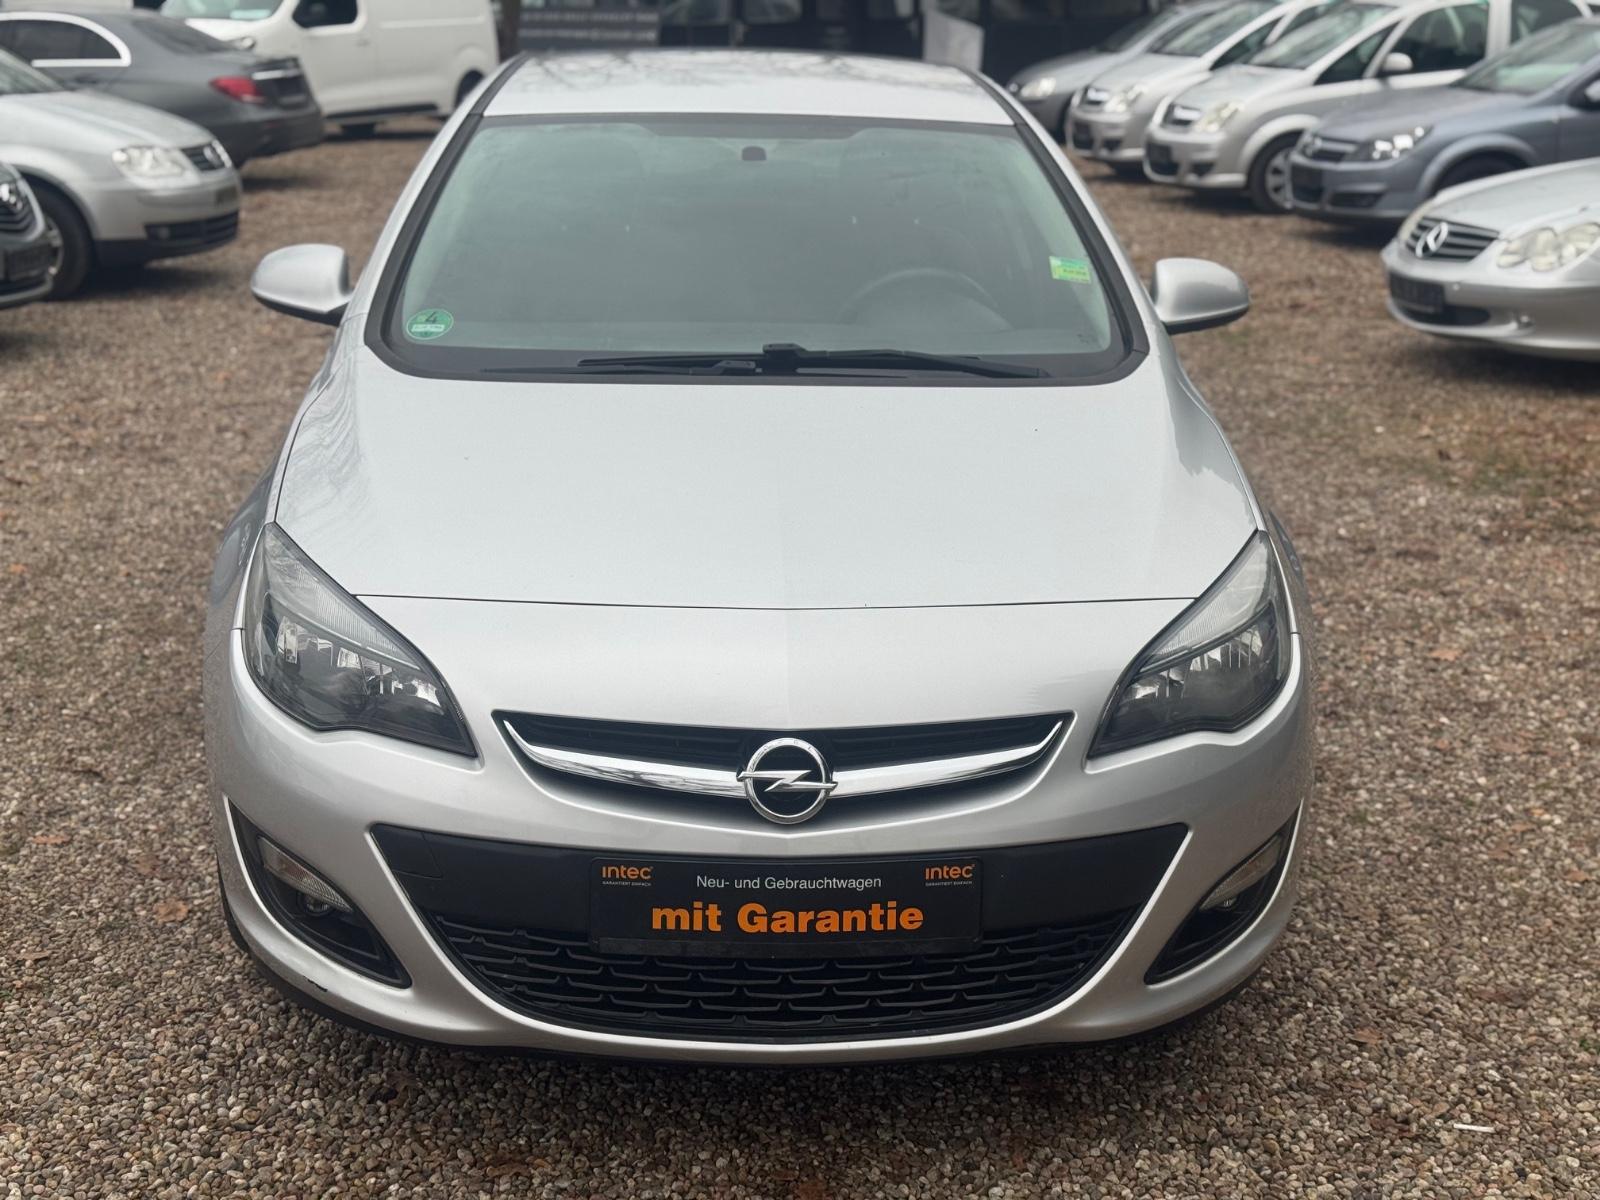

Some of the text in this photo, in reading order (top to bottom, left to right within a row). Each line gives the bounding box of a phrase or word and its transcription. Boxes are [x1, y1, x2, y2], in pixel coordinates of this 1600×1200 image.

[425, 311, 438, 324] 4
[602, 865, 652, 880] intec
[925, 864, 973, 880] intec
[696, 875, 882, 891] Neu- und Gebrauchtwagen
[652, 901, 924, 933] mit Garantie
